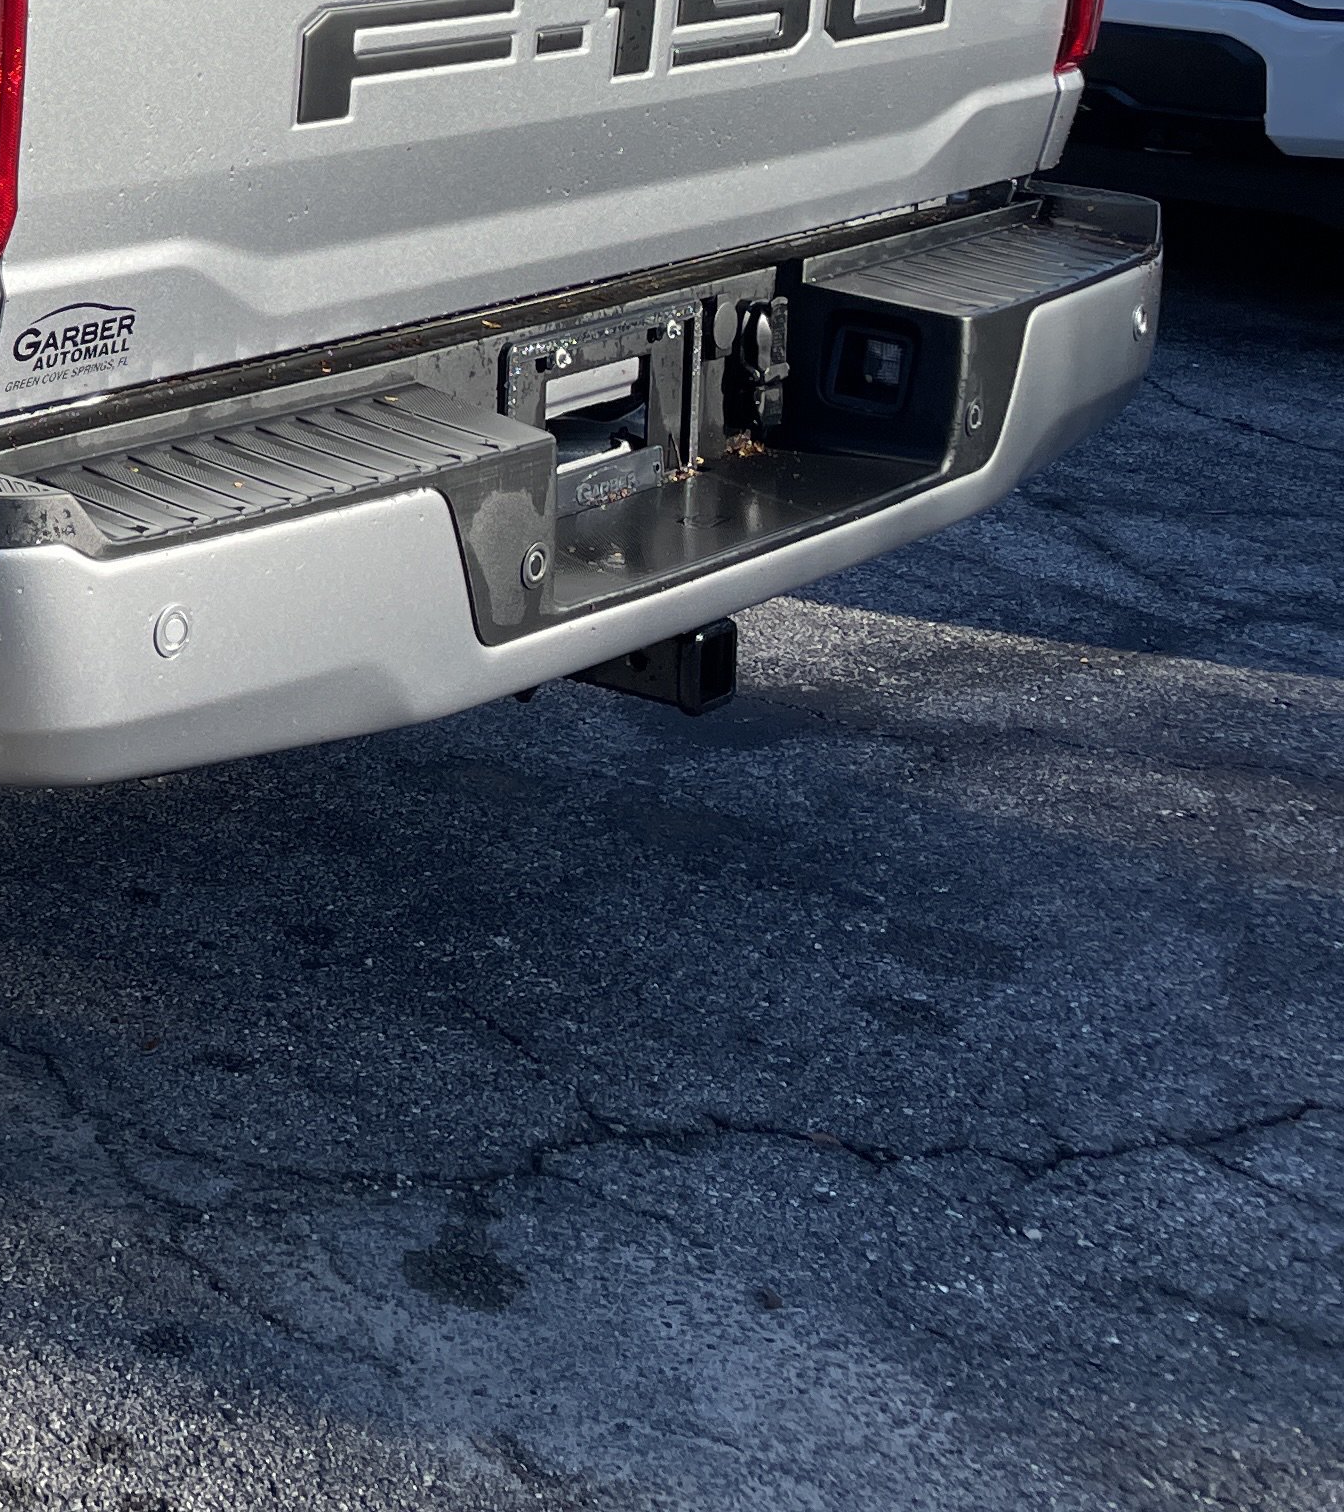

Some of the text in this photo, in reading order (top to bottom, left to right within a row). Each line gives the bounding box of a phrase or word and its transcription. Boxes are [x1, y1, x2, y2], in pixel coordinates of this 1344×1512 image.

[13, 314, 135, 362] GARBER
[32, 337, 130, 372] AUTOMALL
[4, 376, 40, 393] GREEN
[41, 368, 69, 385] COVE
[117, 355, 129, 367] FL
